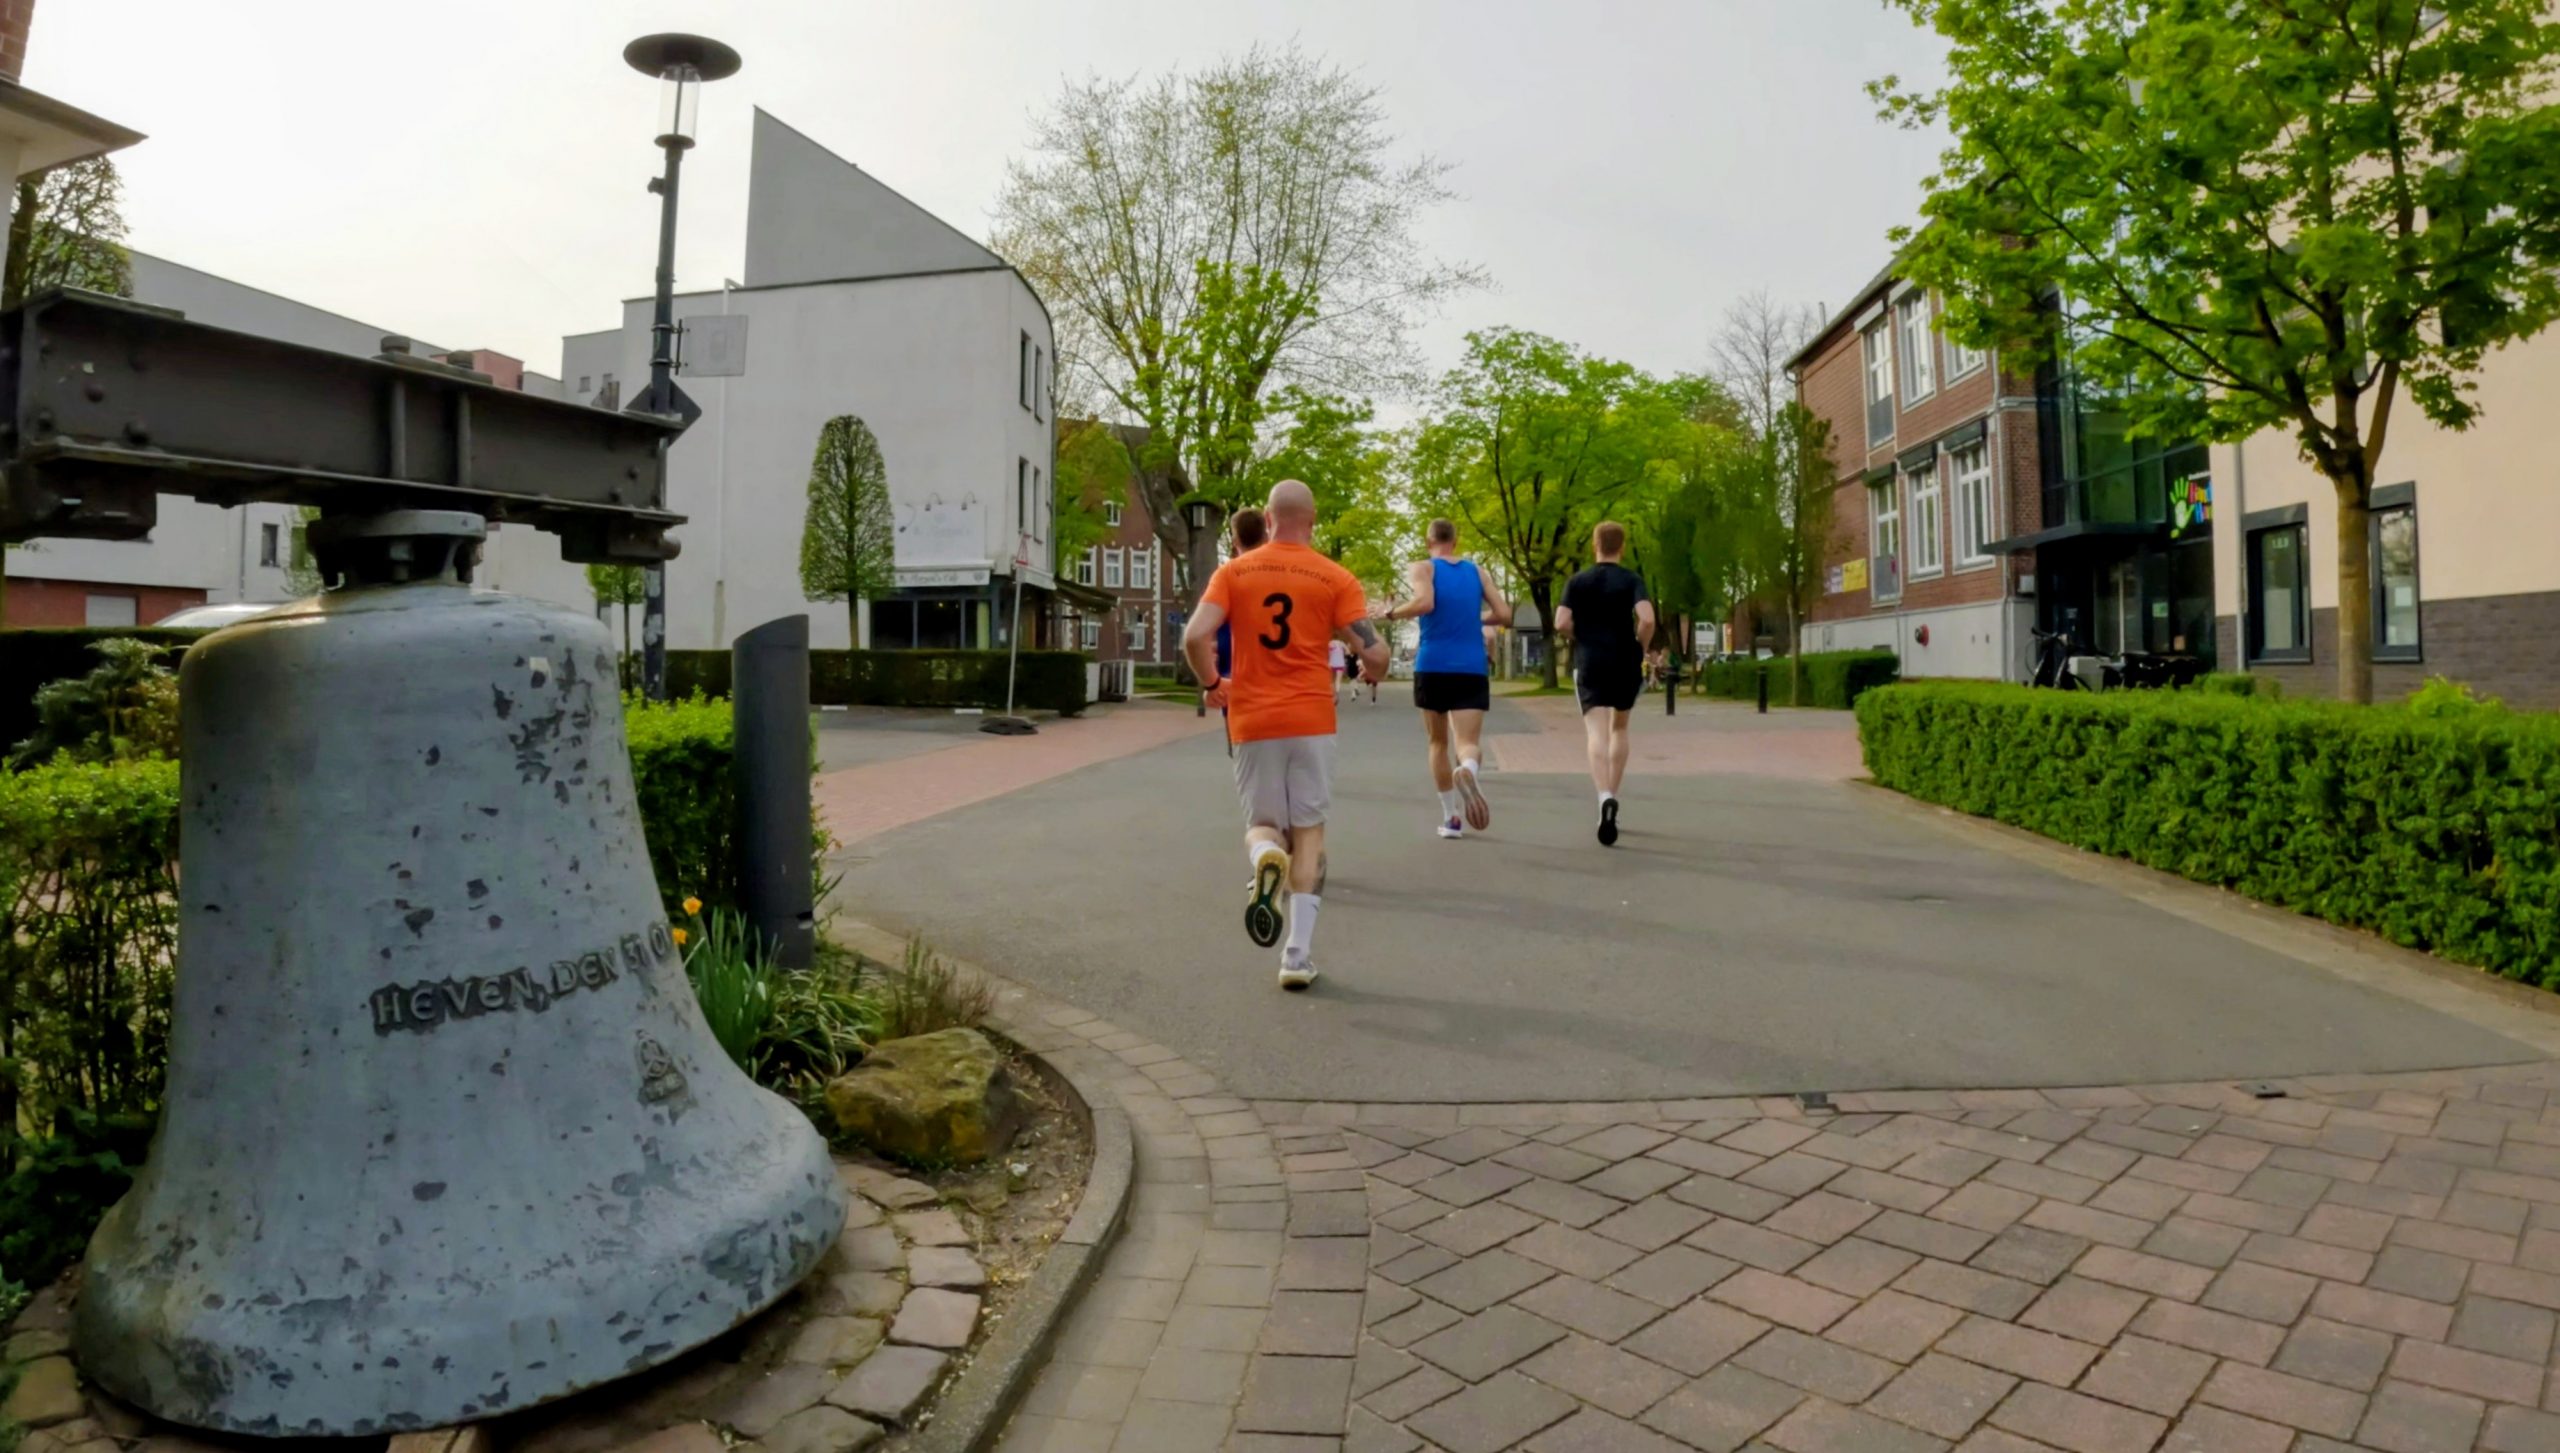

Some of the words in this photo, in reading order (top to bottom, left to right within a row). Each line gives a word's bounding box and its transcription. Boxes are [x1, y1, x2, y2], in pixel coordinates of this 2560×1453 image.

[1234, 564, 1286, 577] Volksbank
[1290, 565, 1332, 585] Gescher
[1259, 593, 1293, 649] 3
[550, 946, 618, 995] DEN
